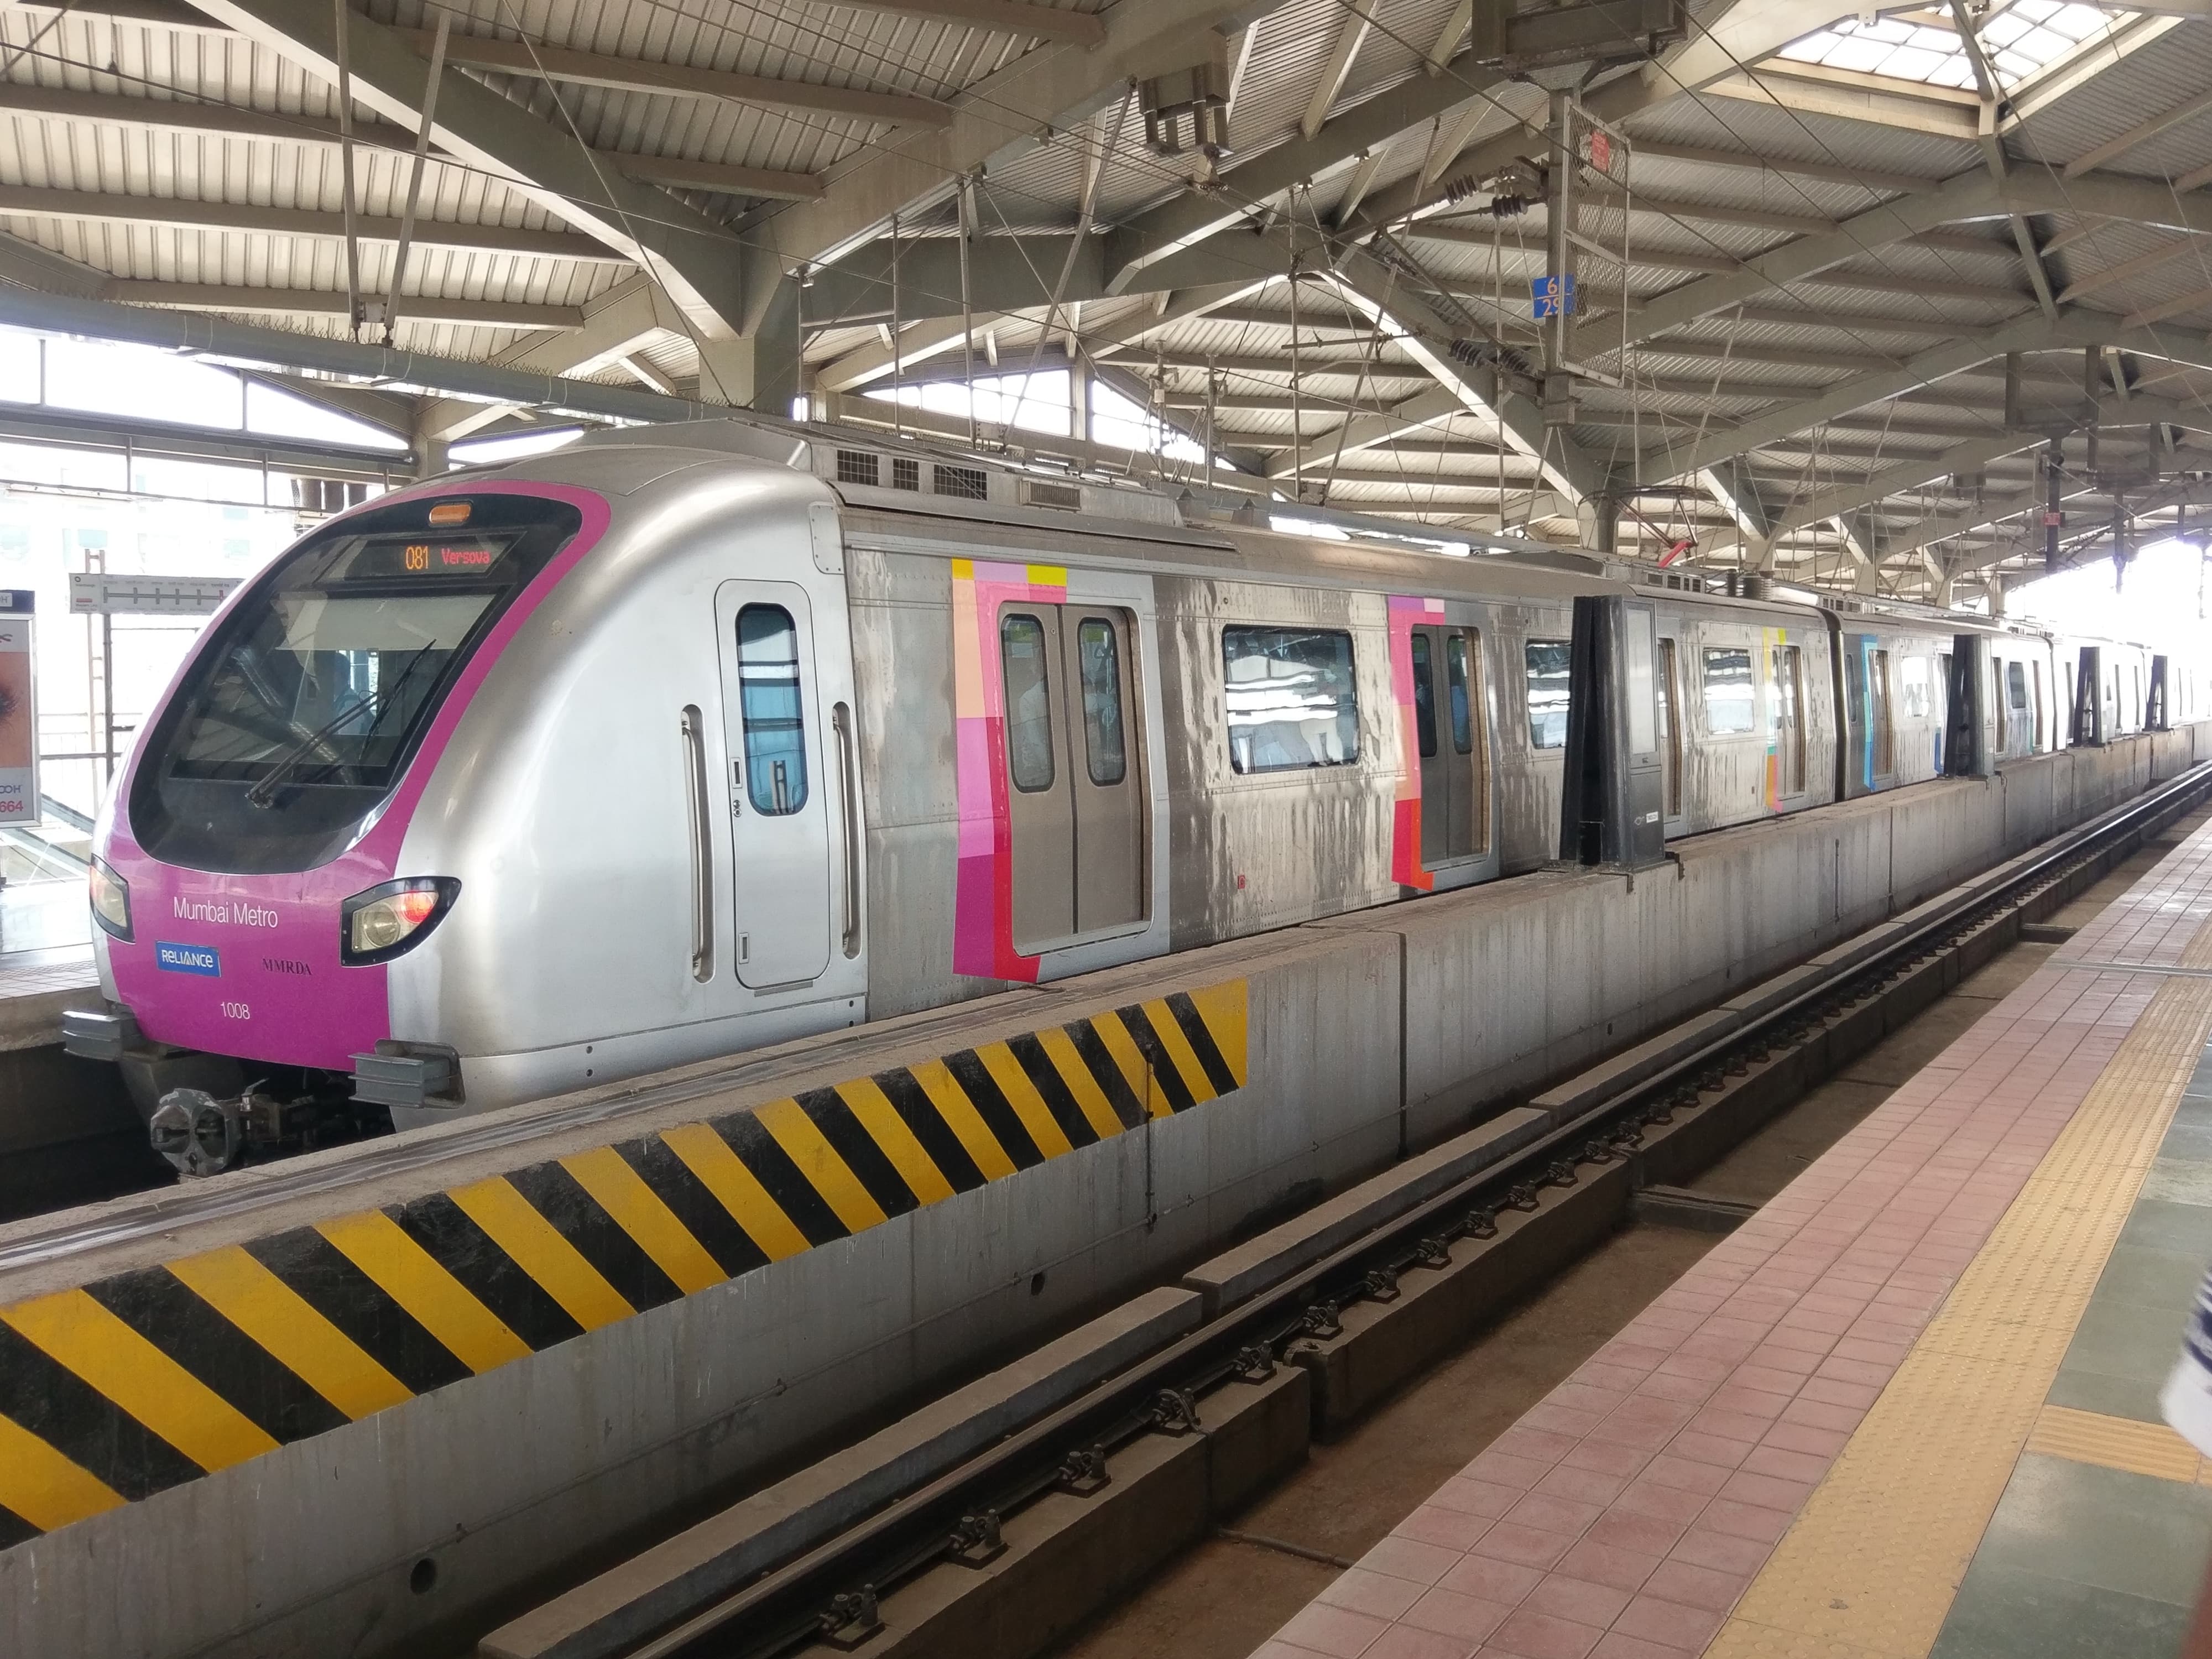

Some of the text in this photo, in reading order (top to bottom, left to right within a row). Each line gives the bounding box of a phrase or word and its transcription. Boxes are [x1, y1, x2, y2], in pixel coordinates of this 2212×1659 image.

[1547, 277, 1557, 294] 6
[406, 545, 490, 570] 081 Versova
[174, 896, 278, 928] Mumbai Metro
[262, 958, 313, 975] MMRDA
[220, 1001, 251, 1020] 1008
